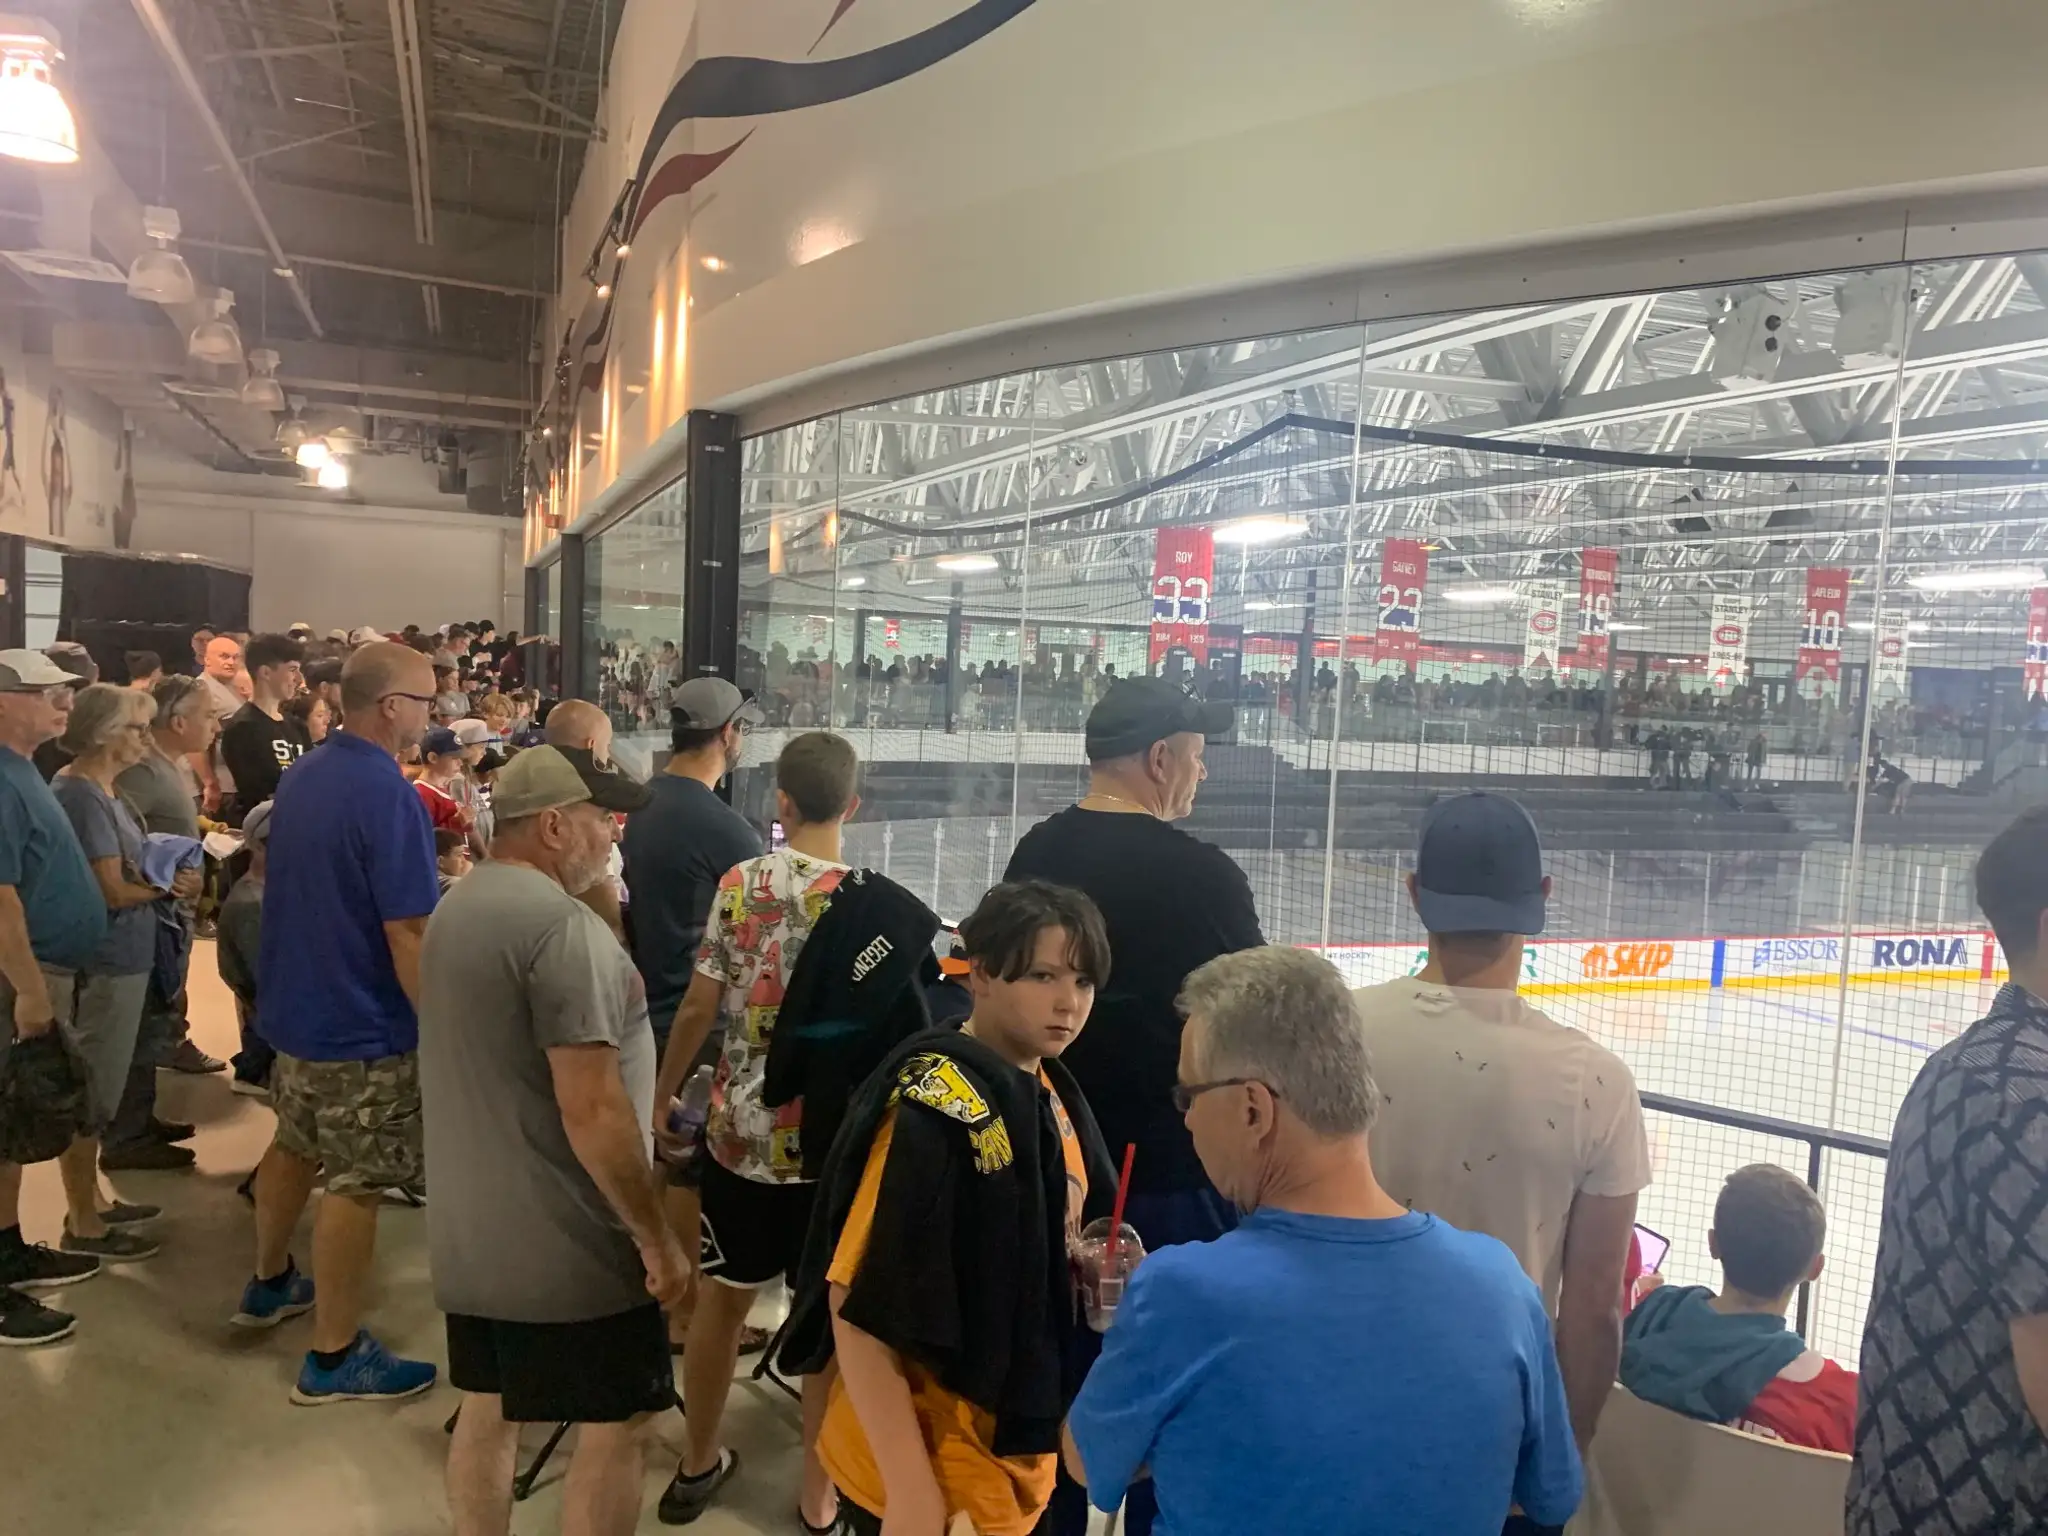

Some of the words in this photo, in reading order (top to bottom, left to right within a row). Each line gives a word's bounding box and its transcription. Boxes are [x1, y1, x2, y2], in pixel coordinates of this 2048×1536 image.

[1175, 551, 1193, 564] ROY
[1156, 575, 1208, 625] 33
[1811, 586, 1842, 599] AFLEUR
[1378, 584, 1423, 633] 23
[1806, 608, 1840, 650] 10
[1608, 944, 1674, 977] SKIP
[1773, 939, 1839, 961] ESSOR
[1874, 938, 1968, 967] RONA
